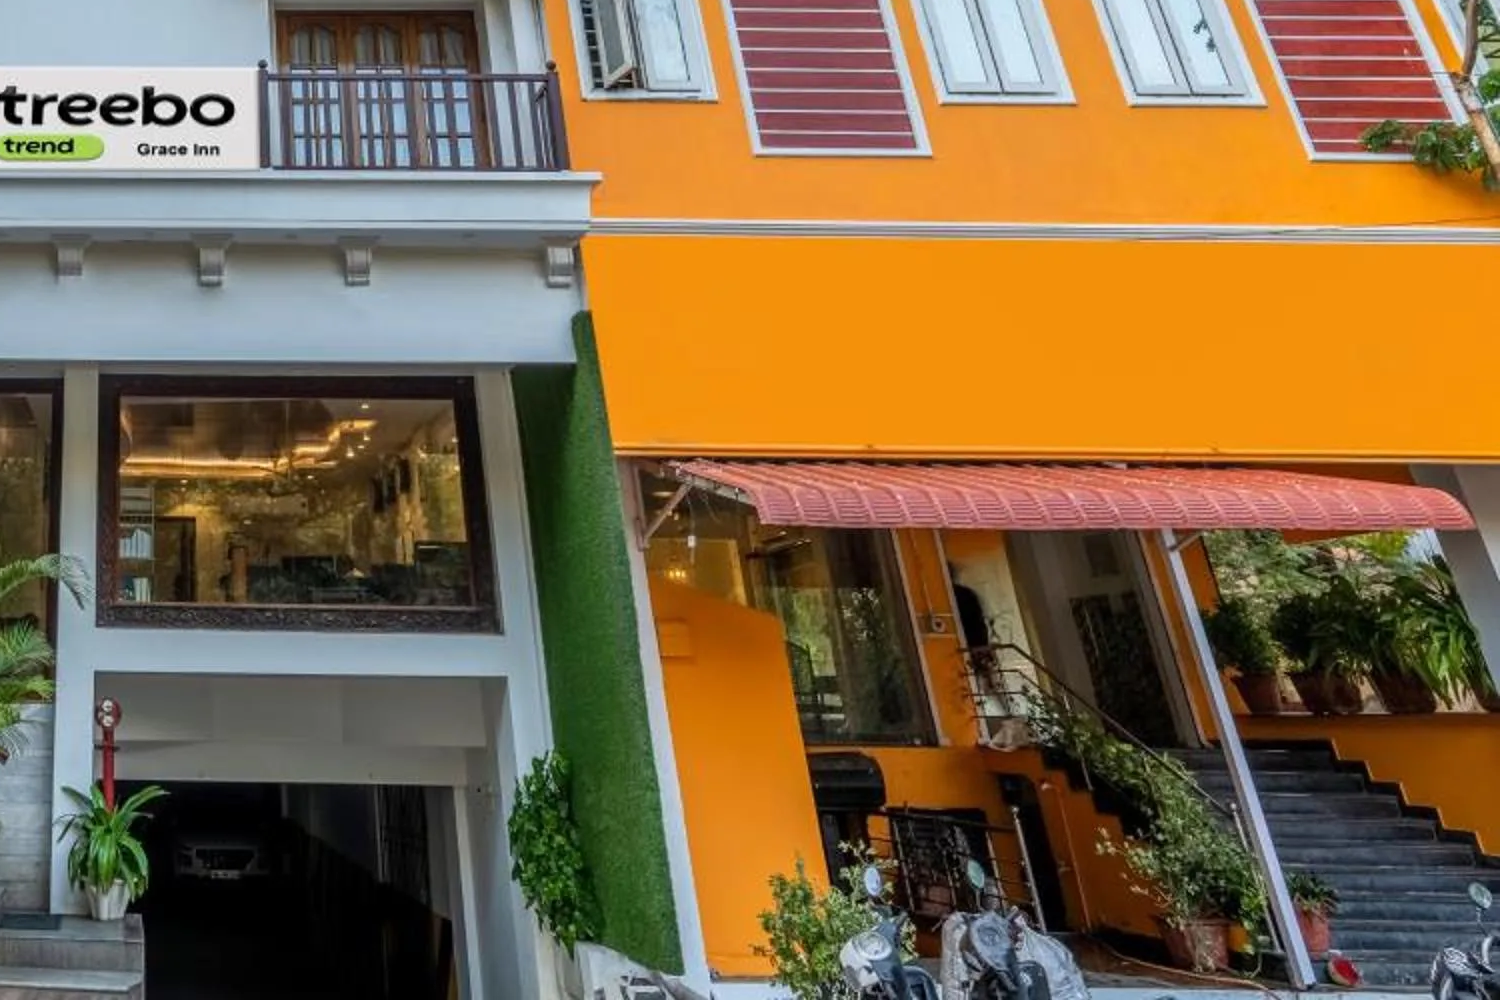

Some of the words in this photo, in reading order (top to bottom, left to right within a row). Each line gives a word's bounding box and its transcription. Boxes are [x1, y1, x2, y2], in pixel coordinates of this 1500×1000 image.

[3, 137, 74, 155] trend
[137, 142, 188, 156] Grace
[193, 142, 221, 156] Inn
